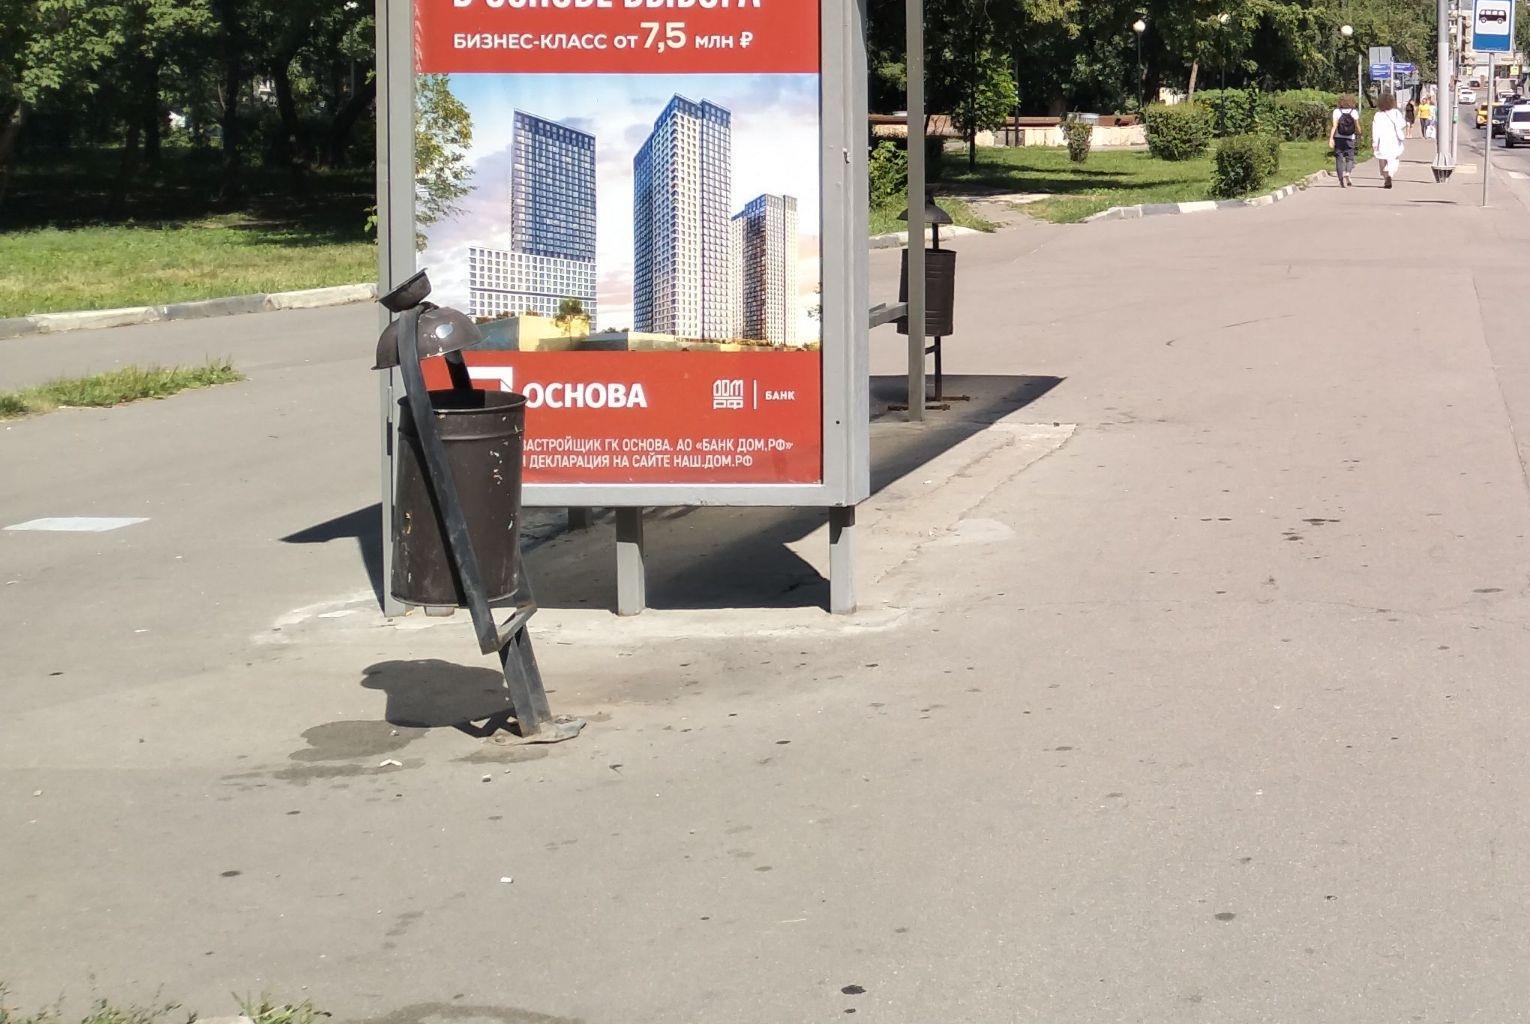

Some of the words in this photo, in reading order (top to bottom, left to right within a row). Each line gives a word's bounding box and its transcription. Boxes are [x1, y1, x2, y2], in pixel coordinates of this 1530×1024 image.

[453, 33, 608, 50] БИЗНЕС-КЛАСС
[640, 22, 687, 54] 7,5
[522, 382, 648, 409] ОСНОВА
[765, 390, 796, 401] БАНК
[605, 438, 619, 451] ГК
[622, 438, 673, 452] ОСНОВА.
[676, 438, 693, 452] АО
[695, 438, 735, 452] «БАНК
[737, 438, 794, 453] ДОМ.РФ»
[529, 454, 610, 469] ДЕКЛАРАЦИЯ
[613, 455, 629, 467] НА
[632, 452, 671, 467] САЙТЕ
[673, 454, 753, 469] НАШ.ДОМ.РФ
